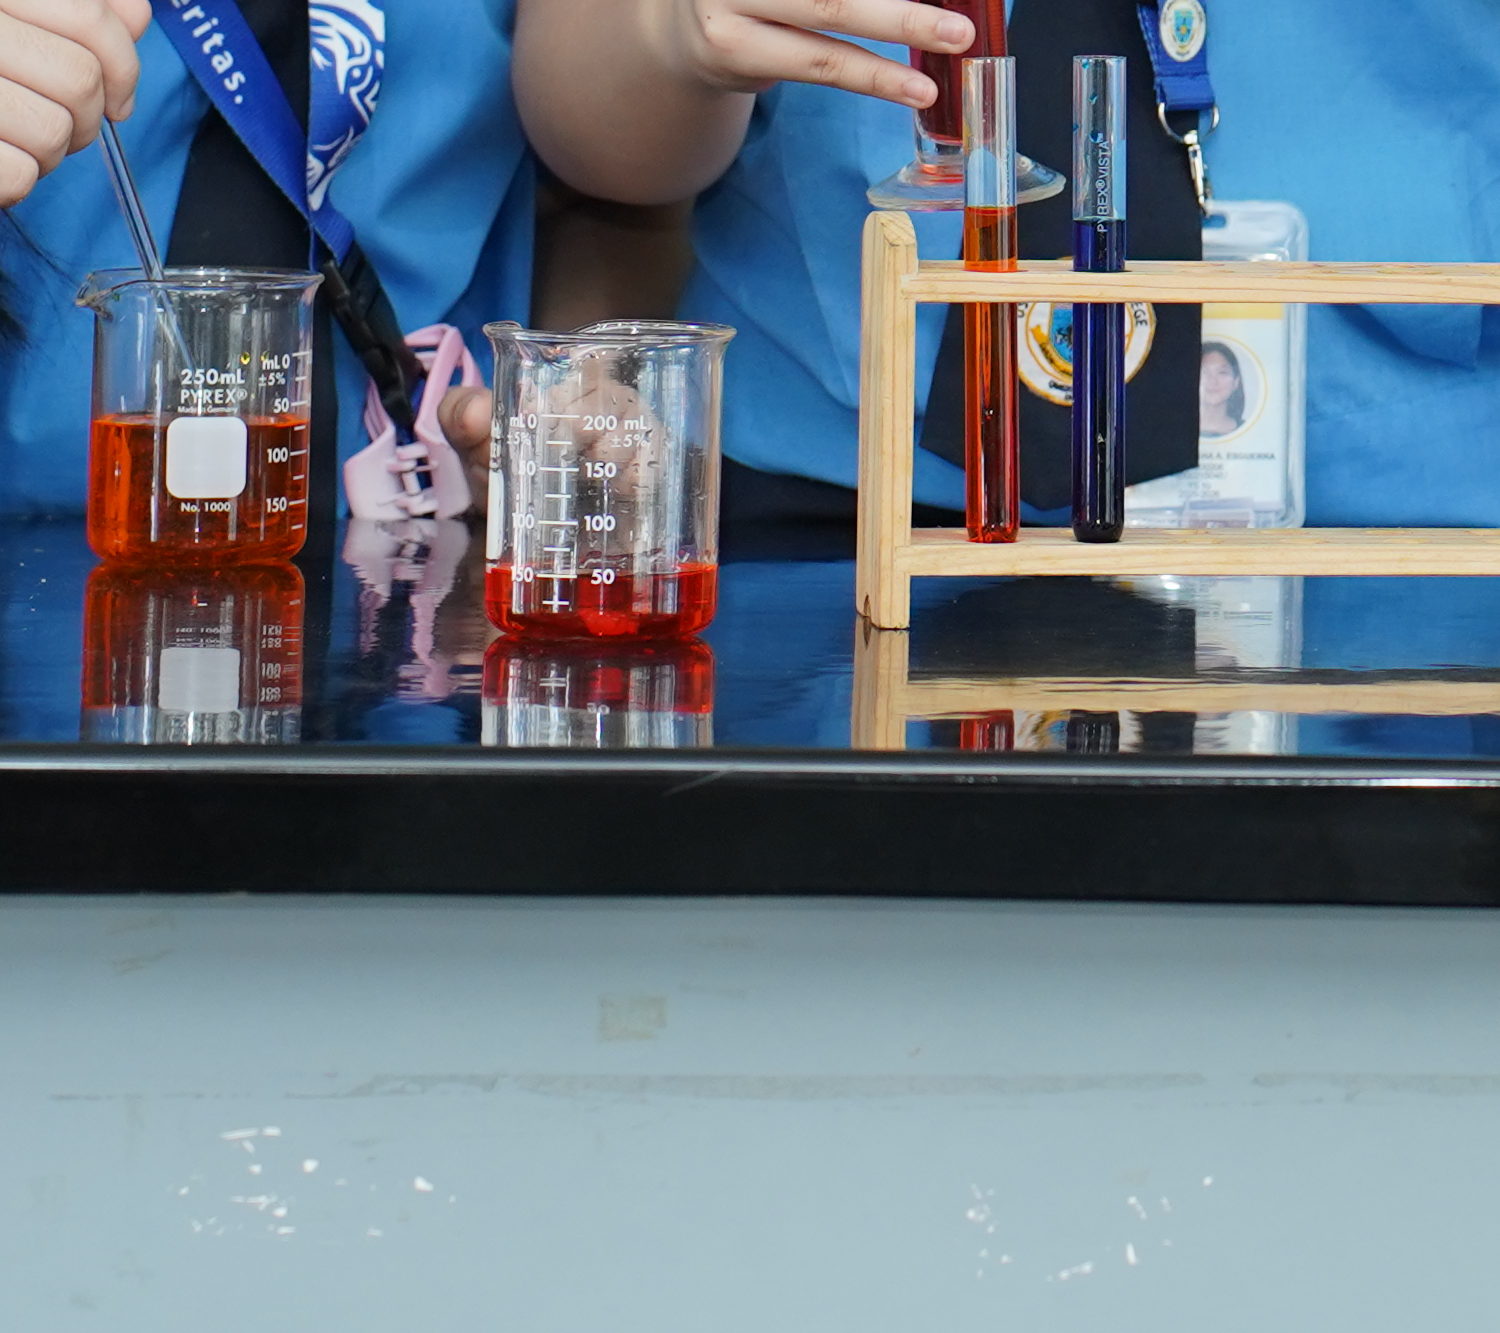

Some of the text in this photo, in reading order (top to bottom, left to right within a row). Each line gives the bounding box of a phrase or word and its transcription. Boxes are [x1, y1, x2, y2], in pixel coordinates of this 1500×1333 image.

[262, 354, 291, 371] mL 0
[258, 371, 286, 387] ±5%
[207, 405, 239, 415] Germany
[273, 397, 290, 414] 50
[527, 413, 537, 429] 0
[582, 414, 651, 431] 200 mL
[611, 433, 652, 449] ±5%
[267, 447, 289, 464] 100
[585, 461, 617, 478] 150
[181, 501, 232, 513] No. 1000
[266, 497, 288, 513] 150
[512, 512, 535, 529] 100
[584, 515, 616, 532] 100
[590, 568, 615, 585] 50
